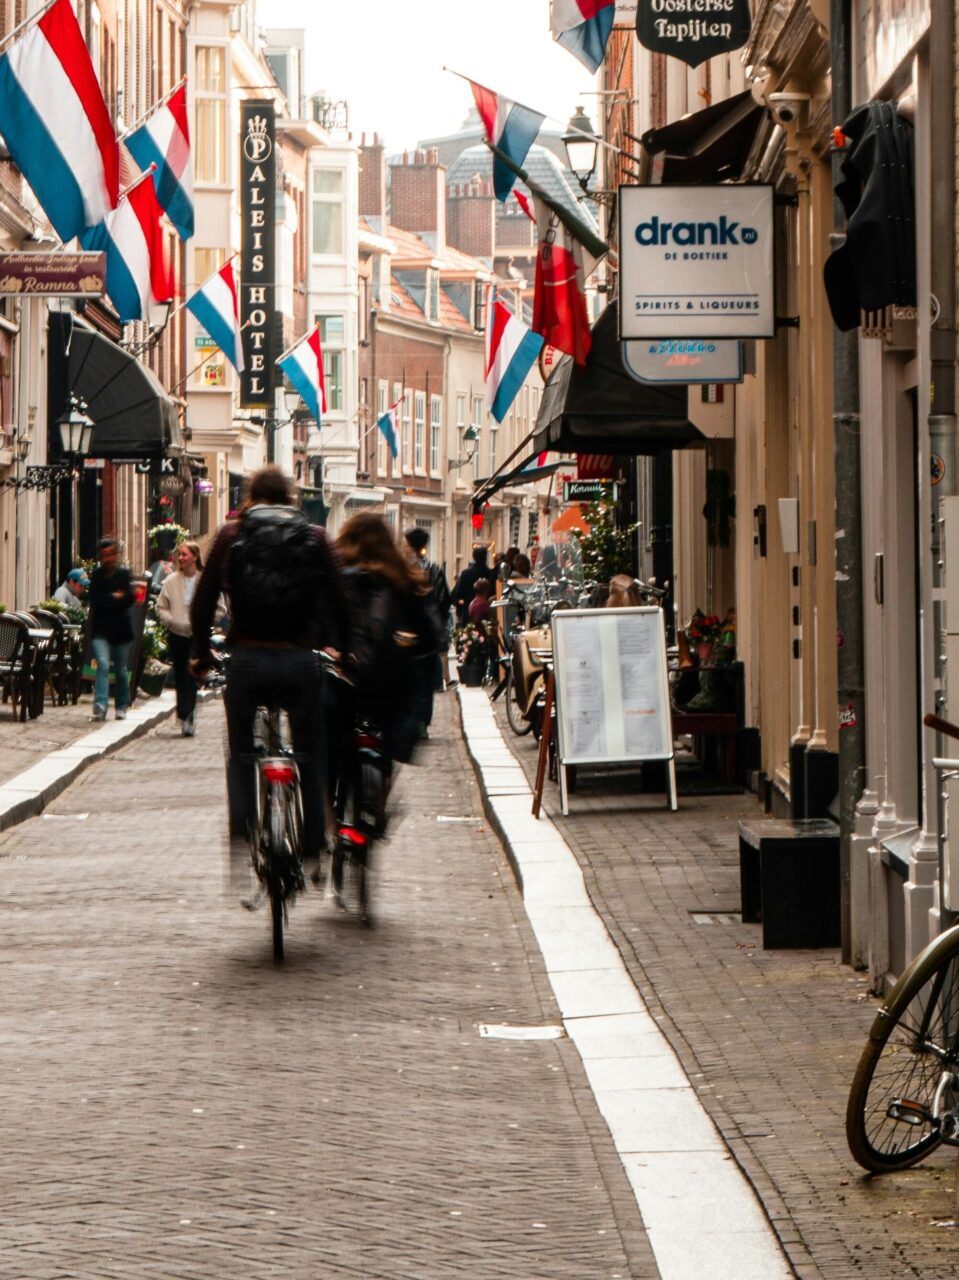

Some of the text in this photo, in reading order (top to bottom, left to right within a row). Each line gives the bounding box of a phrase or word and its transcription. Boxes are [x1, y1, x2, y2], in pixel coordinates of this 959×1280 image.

[655, 19, 732, 42] Tapijten
[249, 138, 266, 272] PALEIS
[683, 252, 728, 260] BOETIEK
[35, 264, 78, 273] restaurant
[24, 276, 77, 293] Ramna
[635, 300, 759, 310] SPIRITS & LIQUEURS
[249, 287, 266, 394] HOTEL
[648, 344, 716, 353] AZZURRO
